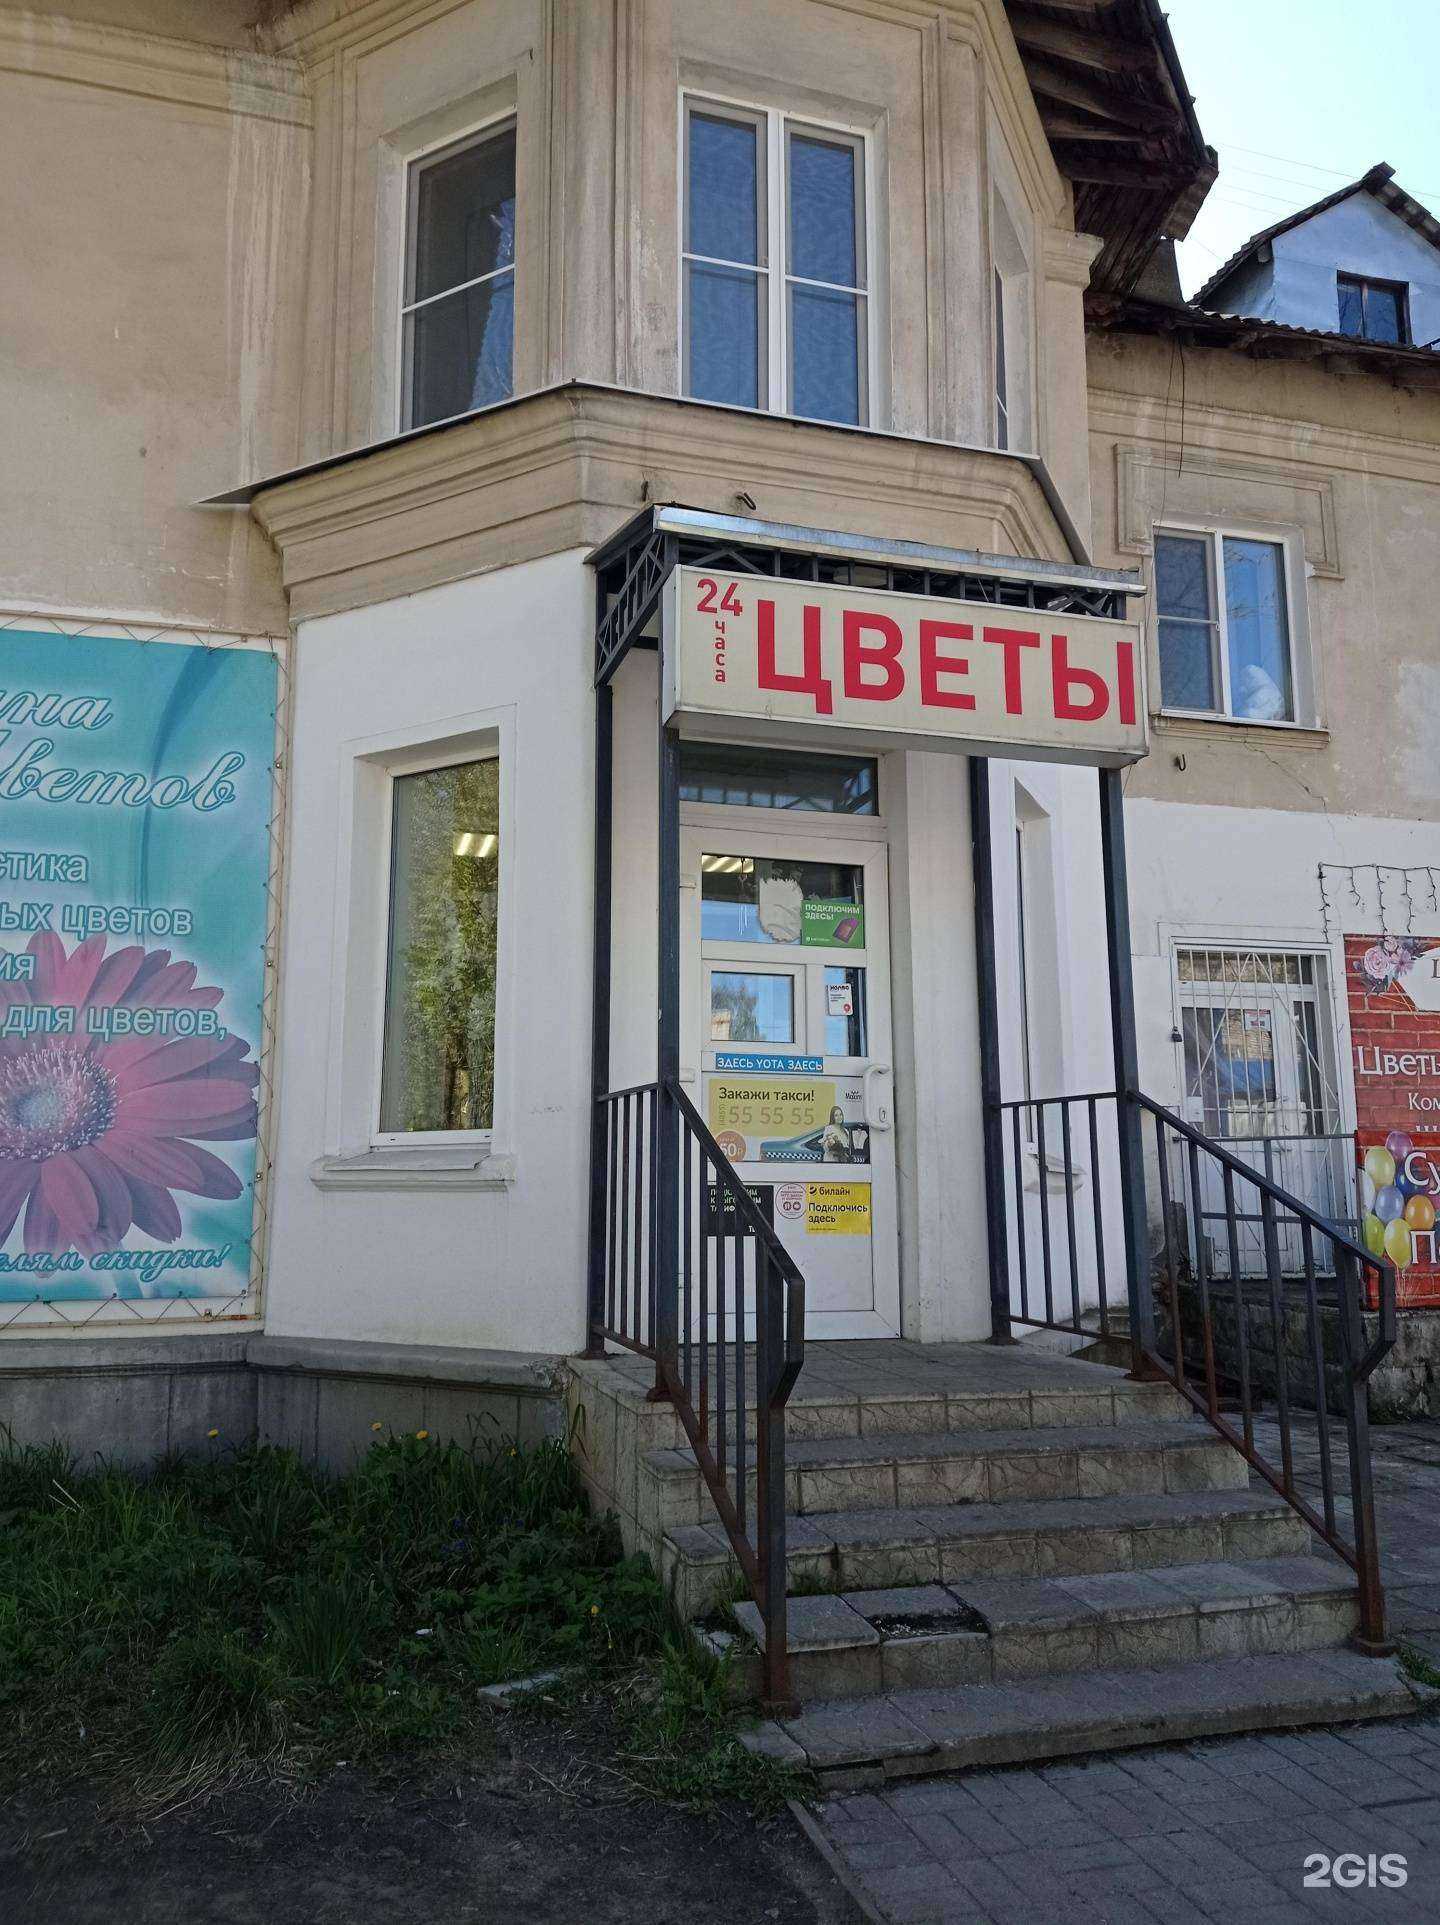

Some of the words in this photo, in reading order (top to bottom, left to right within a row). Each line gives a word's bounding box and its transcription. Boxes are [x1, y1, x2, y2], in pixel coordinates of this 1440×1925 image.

[697, 578, 743, 617] 24
[714, 620, 727, 683] часа
[757, 599, 1136, 726] ЦВЕТЫ
[62, 904, 193, 941] цветов
[2, 1005, 76, 1039] для
[87, 1006, 228, 1042] цветов,
[717, 1057, 754, 1069] ЗДЕСЬ
[787, 1060, 823, 1072] ЗДЕСЬ
[719, 1087, 770, 1101] Закажи
[774, 1089, 815, 1102] такси!
[728, 1106, 753, 1125] 55
[760, 1106, 784, 1125] 55
[790, 1107, 815, 1126] 55
[819, 1186, 850, 1196] билайн
[808, 1202, 868, 1213] Подключись
[808, 1215, 836, 1224] здесь
